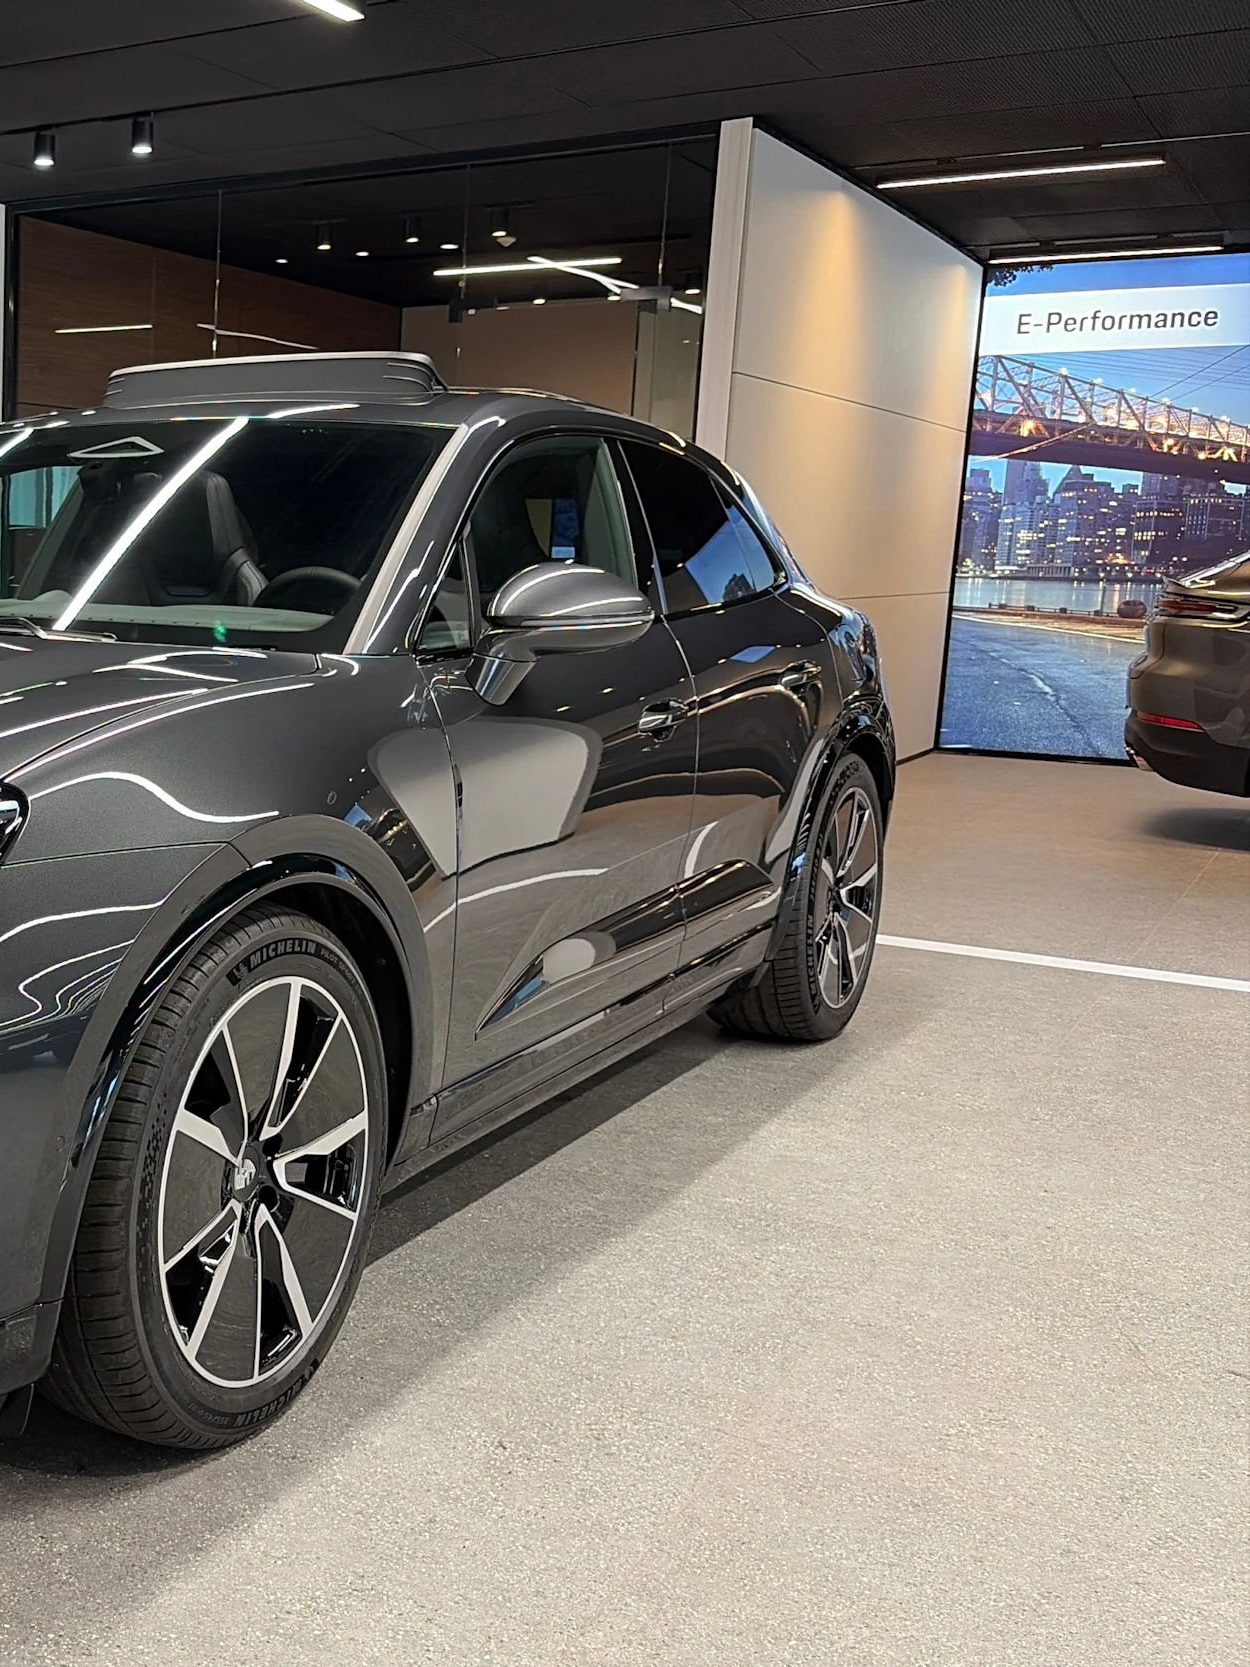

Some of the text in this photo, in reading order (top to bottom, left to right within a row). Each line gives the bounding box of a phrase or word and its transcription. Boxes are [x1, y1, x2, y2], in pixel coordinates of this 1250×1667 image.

[1016, 309, 1219, 335] E-Performance
[250, 940, 317, 968] MICHELIN
[320, 948, 338, 964] PILOT
[234, 1381, 301, 1427] MICHELIN
